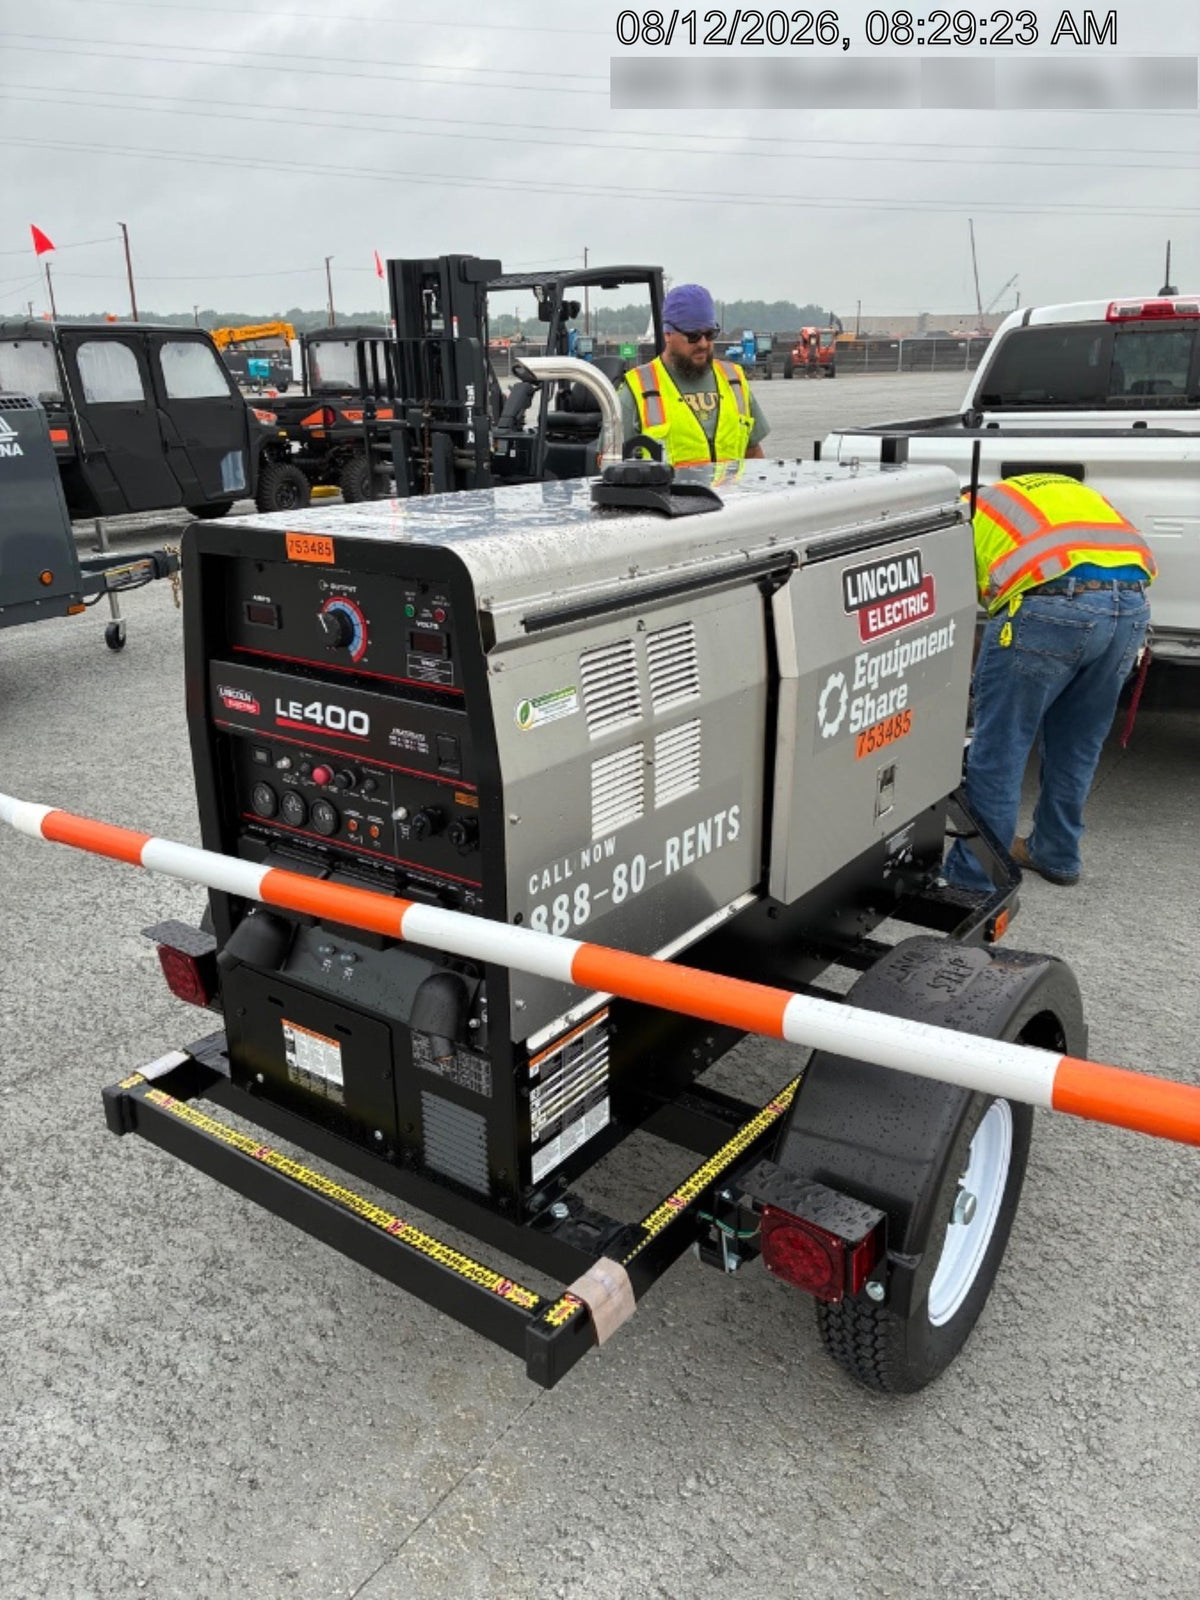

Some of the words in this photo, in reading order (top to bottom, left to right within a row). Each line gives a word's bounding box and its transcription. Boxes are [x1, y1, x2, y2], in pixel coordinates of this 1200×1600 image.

[289, 539, 332, 556] 753485
[846, 556, 919, 606] LINCOLN
[867, 592, 929, 632] ELECTRIC
[853, 619, 956, 690] Equipment
[275, 698, 370, 736] LE400
[849, 683, 908, 734] Share
[857, 709, 911, 758] 753485
[529, 858, 573, 895] CALL
[581, 836, 617, 870] NOW
[530, 804, 741, 937] 888-80-RENTS
